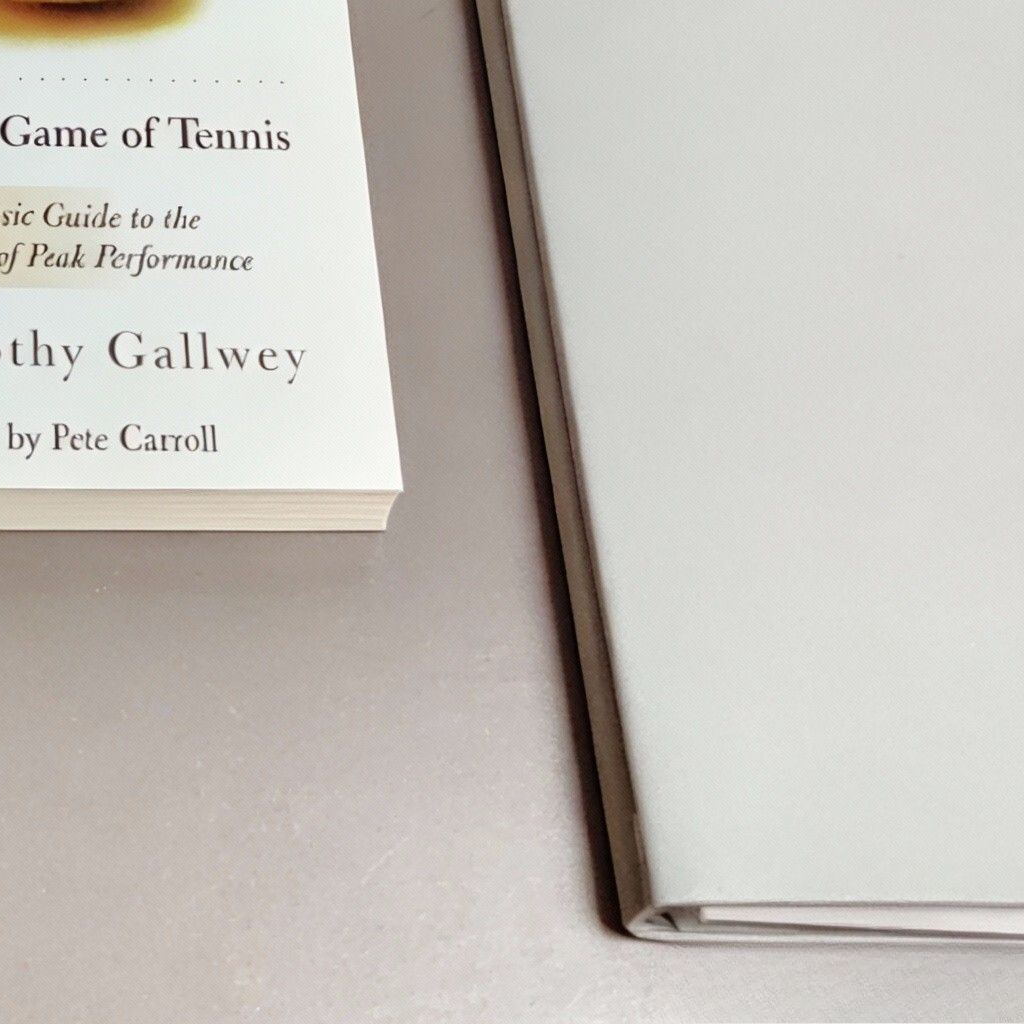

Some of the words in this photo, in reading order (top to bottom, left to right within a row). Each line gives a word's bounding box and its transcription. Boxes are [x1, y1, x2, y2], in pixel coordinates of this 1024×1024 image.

[121, 115, 161, 149] of
[167, 116, 291, 152] Tennis
[42, 202, 122, 229] Guide
[130, 207, 154, 229] to
[163, 205, 201, 230] the
[26, 243, 86, 269] Peak
[93, 243, 254, 278] Performance
[107, 330, 307, 385] Gallwey
[7, 421, 42, 460] by
[51, 422, 109, 452] Pete
[119, 423, 218, 453] Carroll
